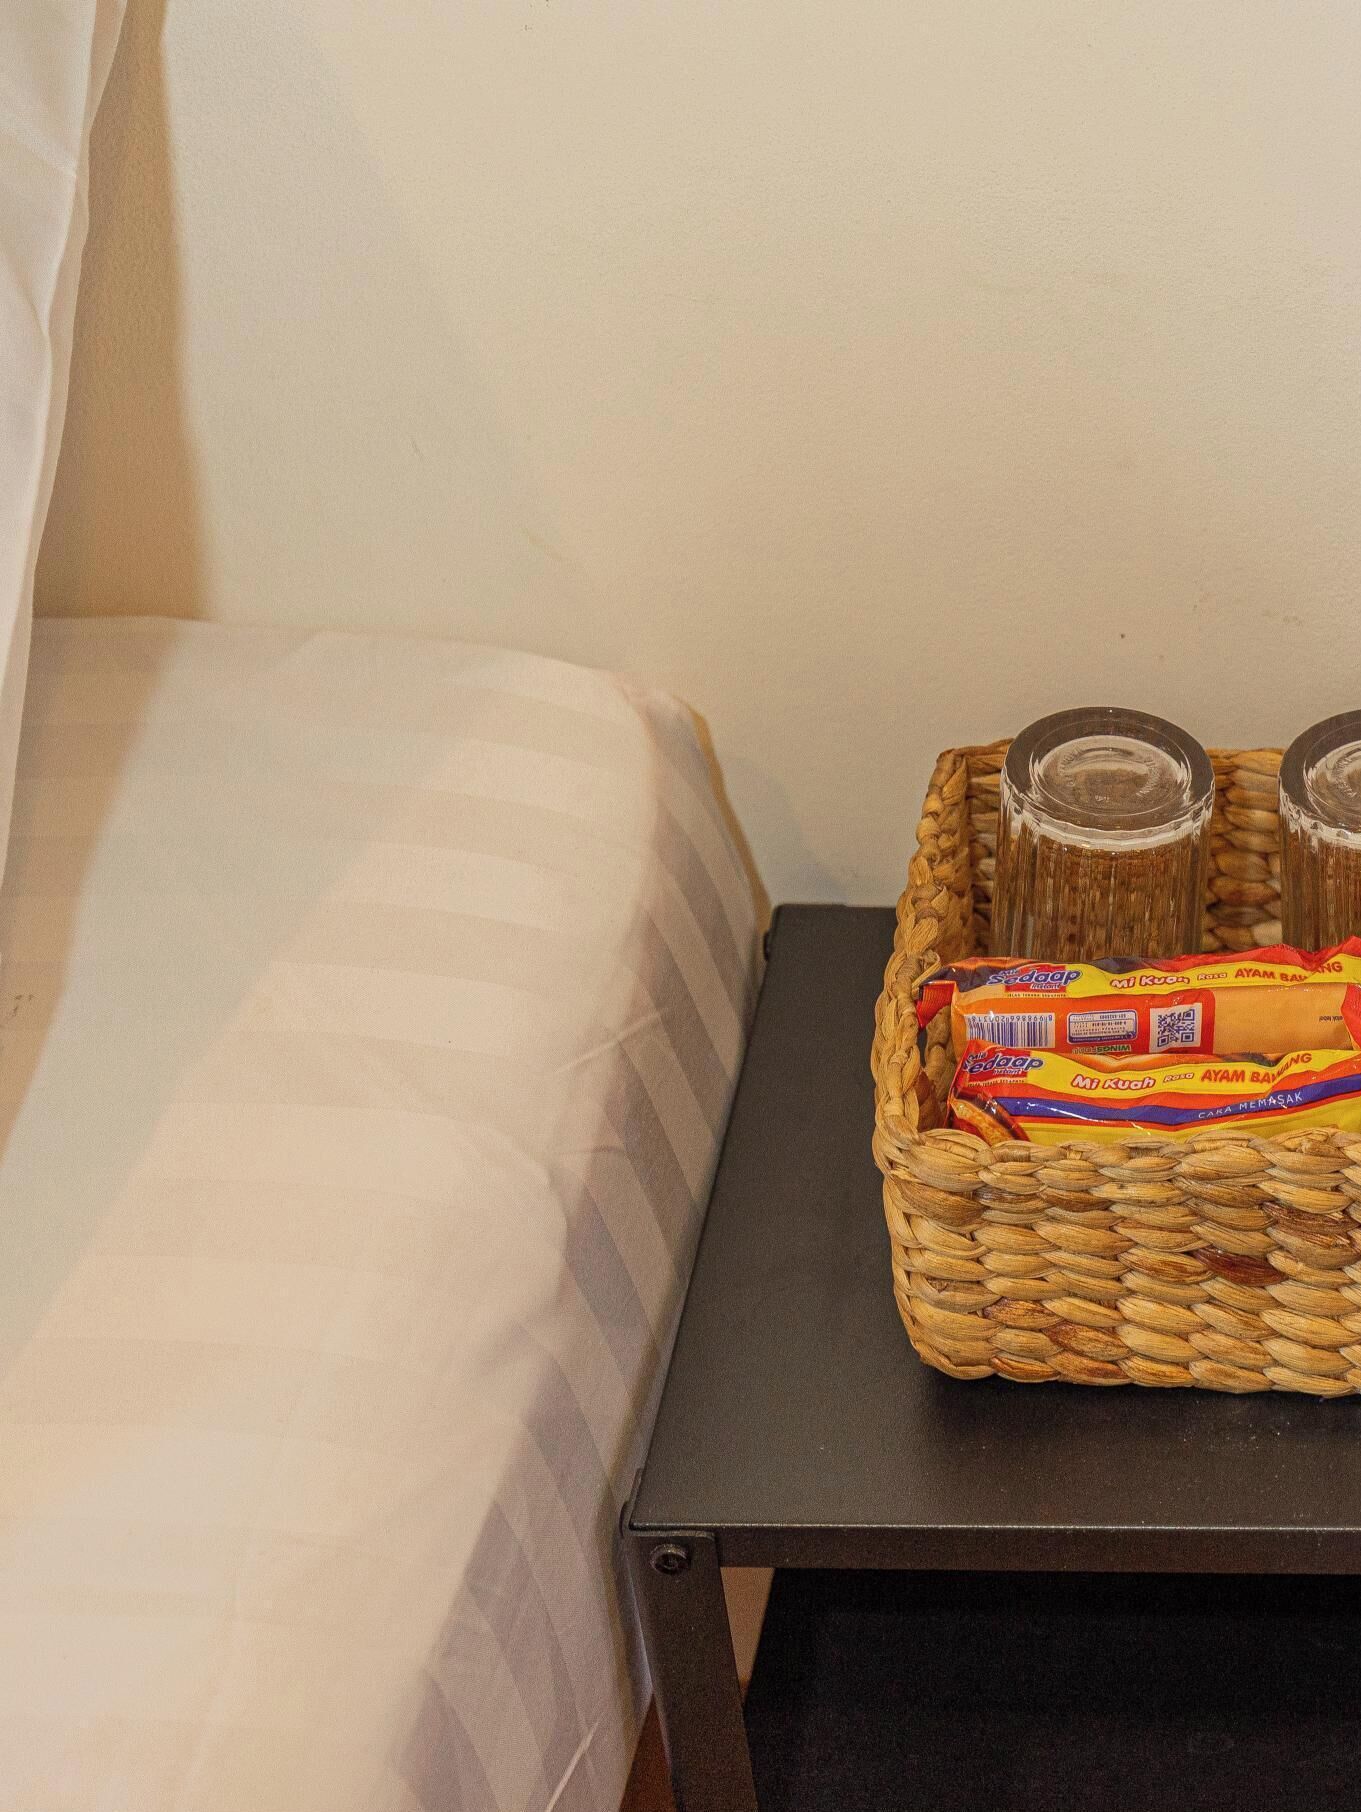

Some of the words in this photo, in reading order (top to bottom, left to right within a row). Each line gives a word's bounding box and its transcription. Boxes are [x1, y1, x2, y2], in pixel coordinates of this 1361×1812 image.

[986, 970, 1082, 986] Sedaap
[1110, 976, 1136, 989] Mi
[1197, 972, 1228, 981] Rasa
[1234, 967, 1276, 980] AYAM
[1071, 1073, 1101, 1091] Mi
[1102, 1076, 1157, 1091] Kuah
[1163, 1072, 1195, 1083] Rasa
[1201, 1069, 1246, 1083] AYAM
[1198, 1107, 1232, 1119] CARA
[1239, 1091, 1303, 1110] MEMASAK
